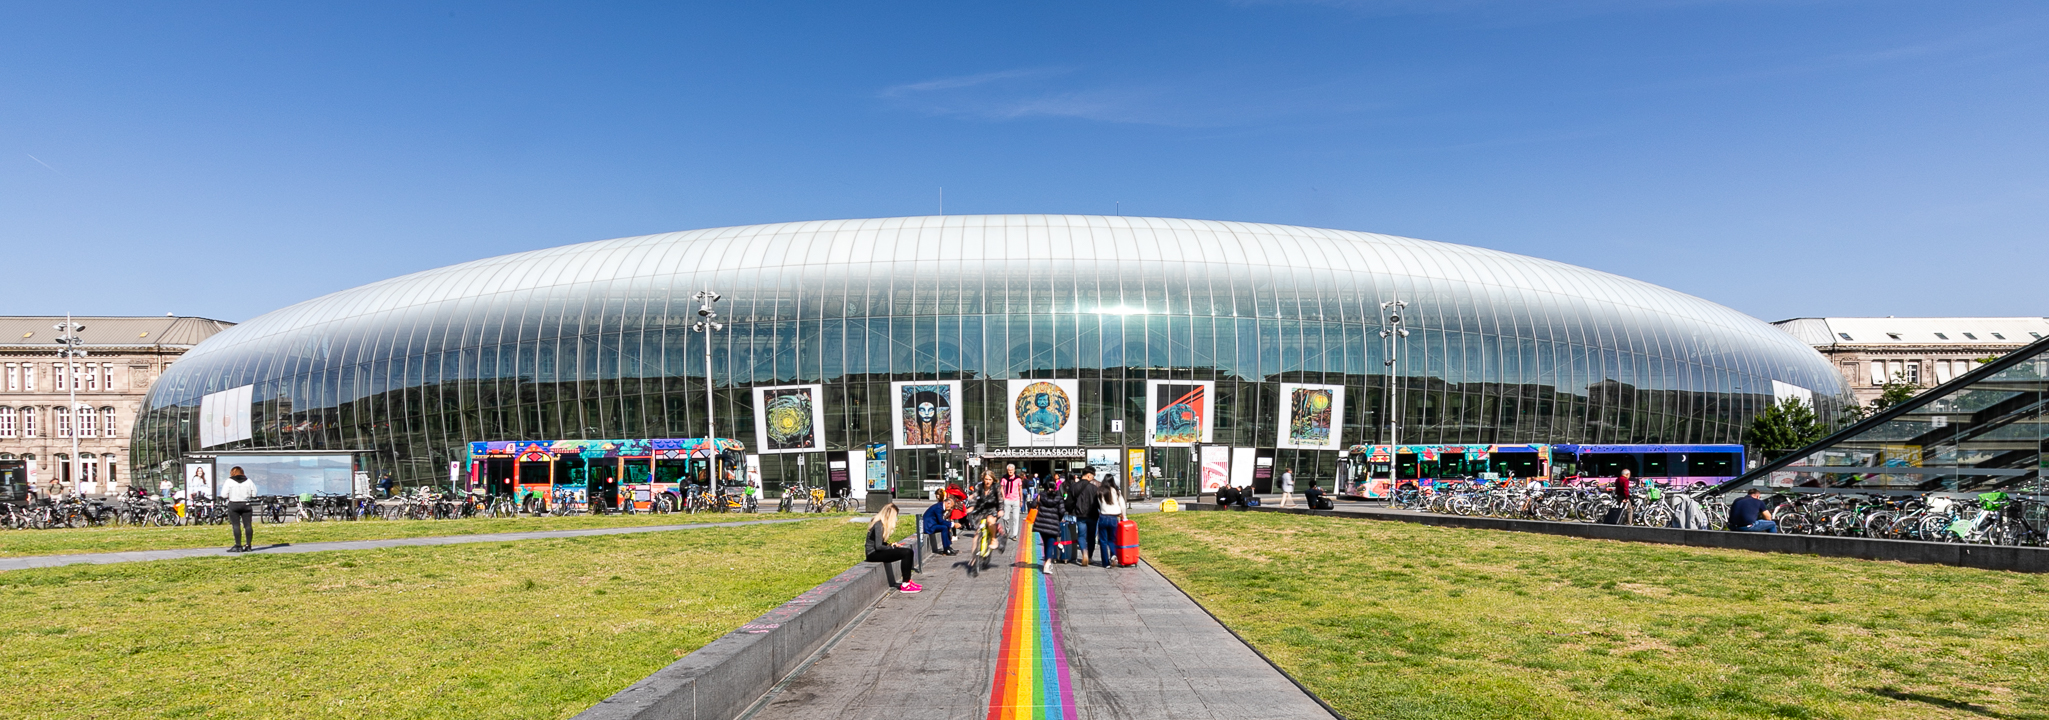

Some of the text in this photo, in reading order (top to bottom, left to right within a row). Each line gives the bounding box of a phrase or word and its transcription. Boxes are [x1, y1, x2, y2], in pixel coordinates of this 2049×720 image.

[994, 448, 1086, 456] GARE DE STRASBOURG
